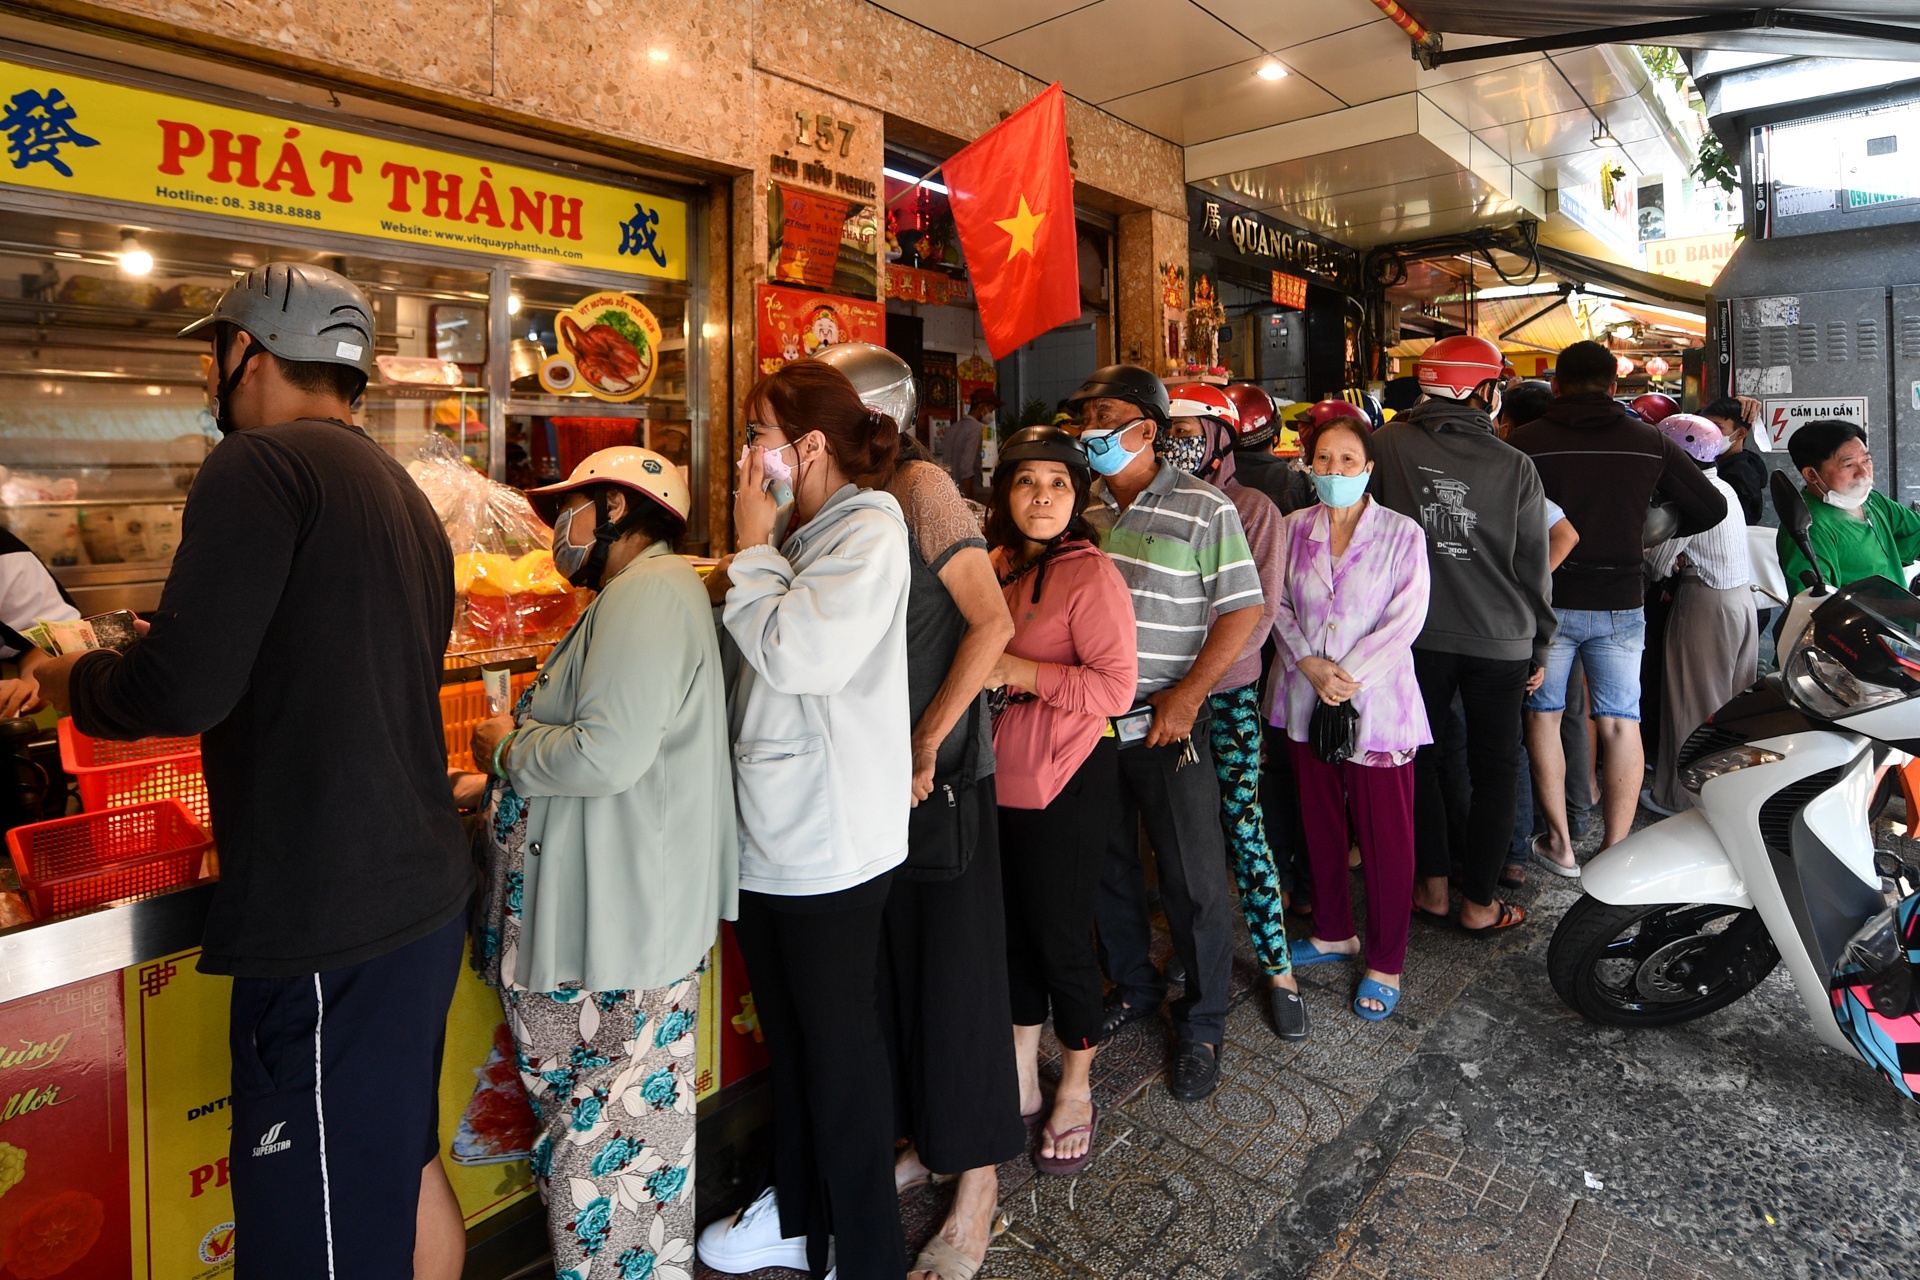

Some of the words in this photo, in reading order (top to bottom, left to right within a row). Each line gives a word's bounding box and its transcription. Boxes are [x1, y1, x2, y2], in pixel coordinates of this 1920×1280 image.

[796, 109, 856, 157] 157
[156, 119, 363, 204] PHÁT
[380, 161, 583, 241] THÀNH
[155, 185, 219, 206] Hotline:
[222, 196, 244, 209] 08.
[248, 199, 322, 221] 3838.8888
[380, 220, 433, 238] Website:
[434, 228, 583, 260] www.vitquayphatthanh.com
[617, 203, 667, 268] 成
[1231, 214, 1293, 263] QUANG
[1790, 405, 1812, 418] CẤM
[1814, 407, 1830, 419] LẠI
[1833, 403, 1853, 416] GẦN
[252, 1138, 292, 1157] SUPERSTAR
